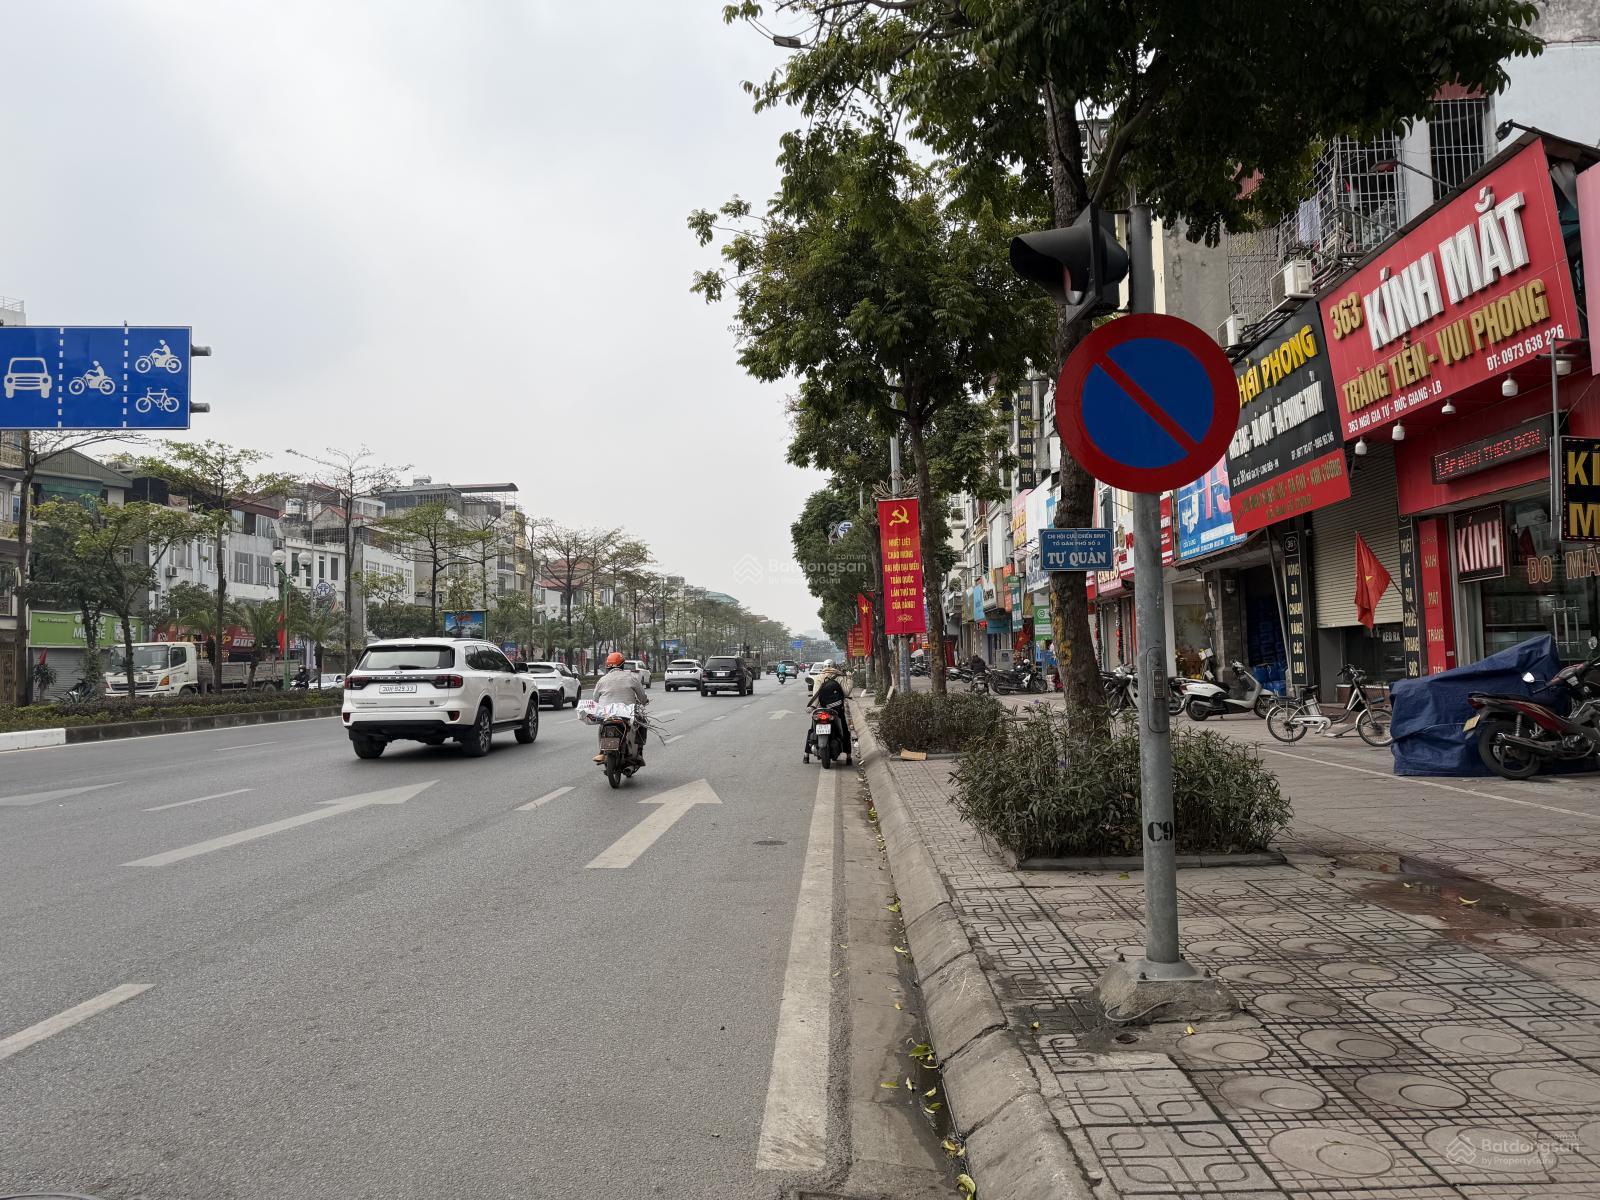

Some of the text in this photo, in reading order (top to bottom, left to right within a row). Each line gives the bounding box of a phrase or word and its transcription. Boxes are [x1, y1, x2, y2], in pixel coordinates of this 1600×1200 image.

[1330, 186, 1530, 351] 363 KÍNH MẮT
[1261, 325, 1318, 389] PHONG
[1341, 363, 1392, 414] TRÀNG
[1388, 336, 1431, 390] TIỀN
[1436, 319, 1473, 366] VUI
[1470, 279, 1550, 350] PHONG
[1501, 342, 1524, 365] 0973
[1524, 334, 1543, 354] 638
[1544, 324, 1564, 346] 226
[1370, 409, 1382, 423] GIA
[1407, 386, 1429, 406] GIANG
[1431, 380, 1442, 396] LB
[1047, 546, 1107, 567] TỰ QUẢN
[1456, 515, 1502, 573] KÍNH
[1147, 821, 1174, 842] C9
